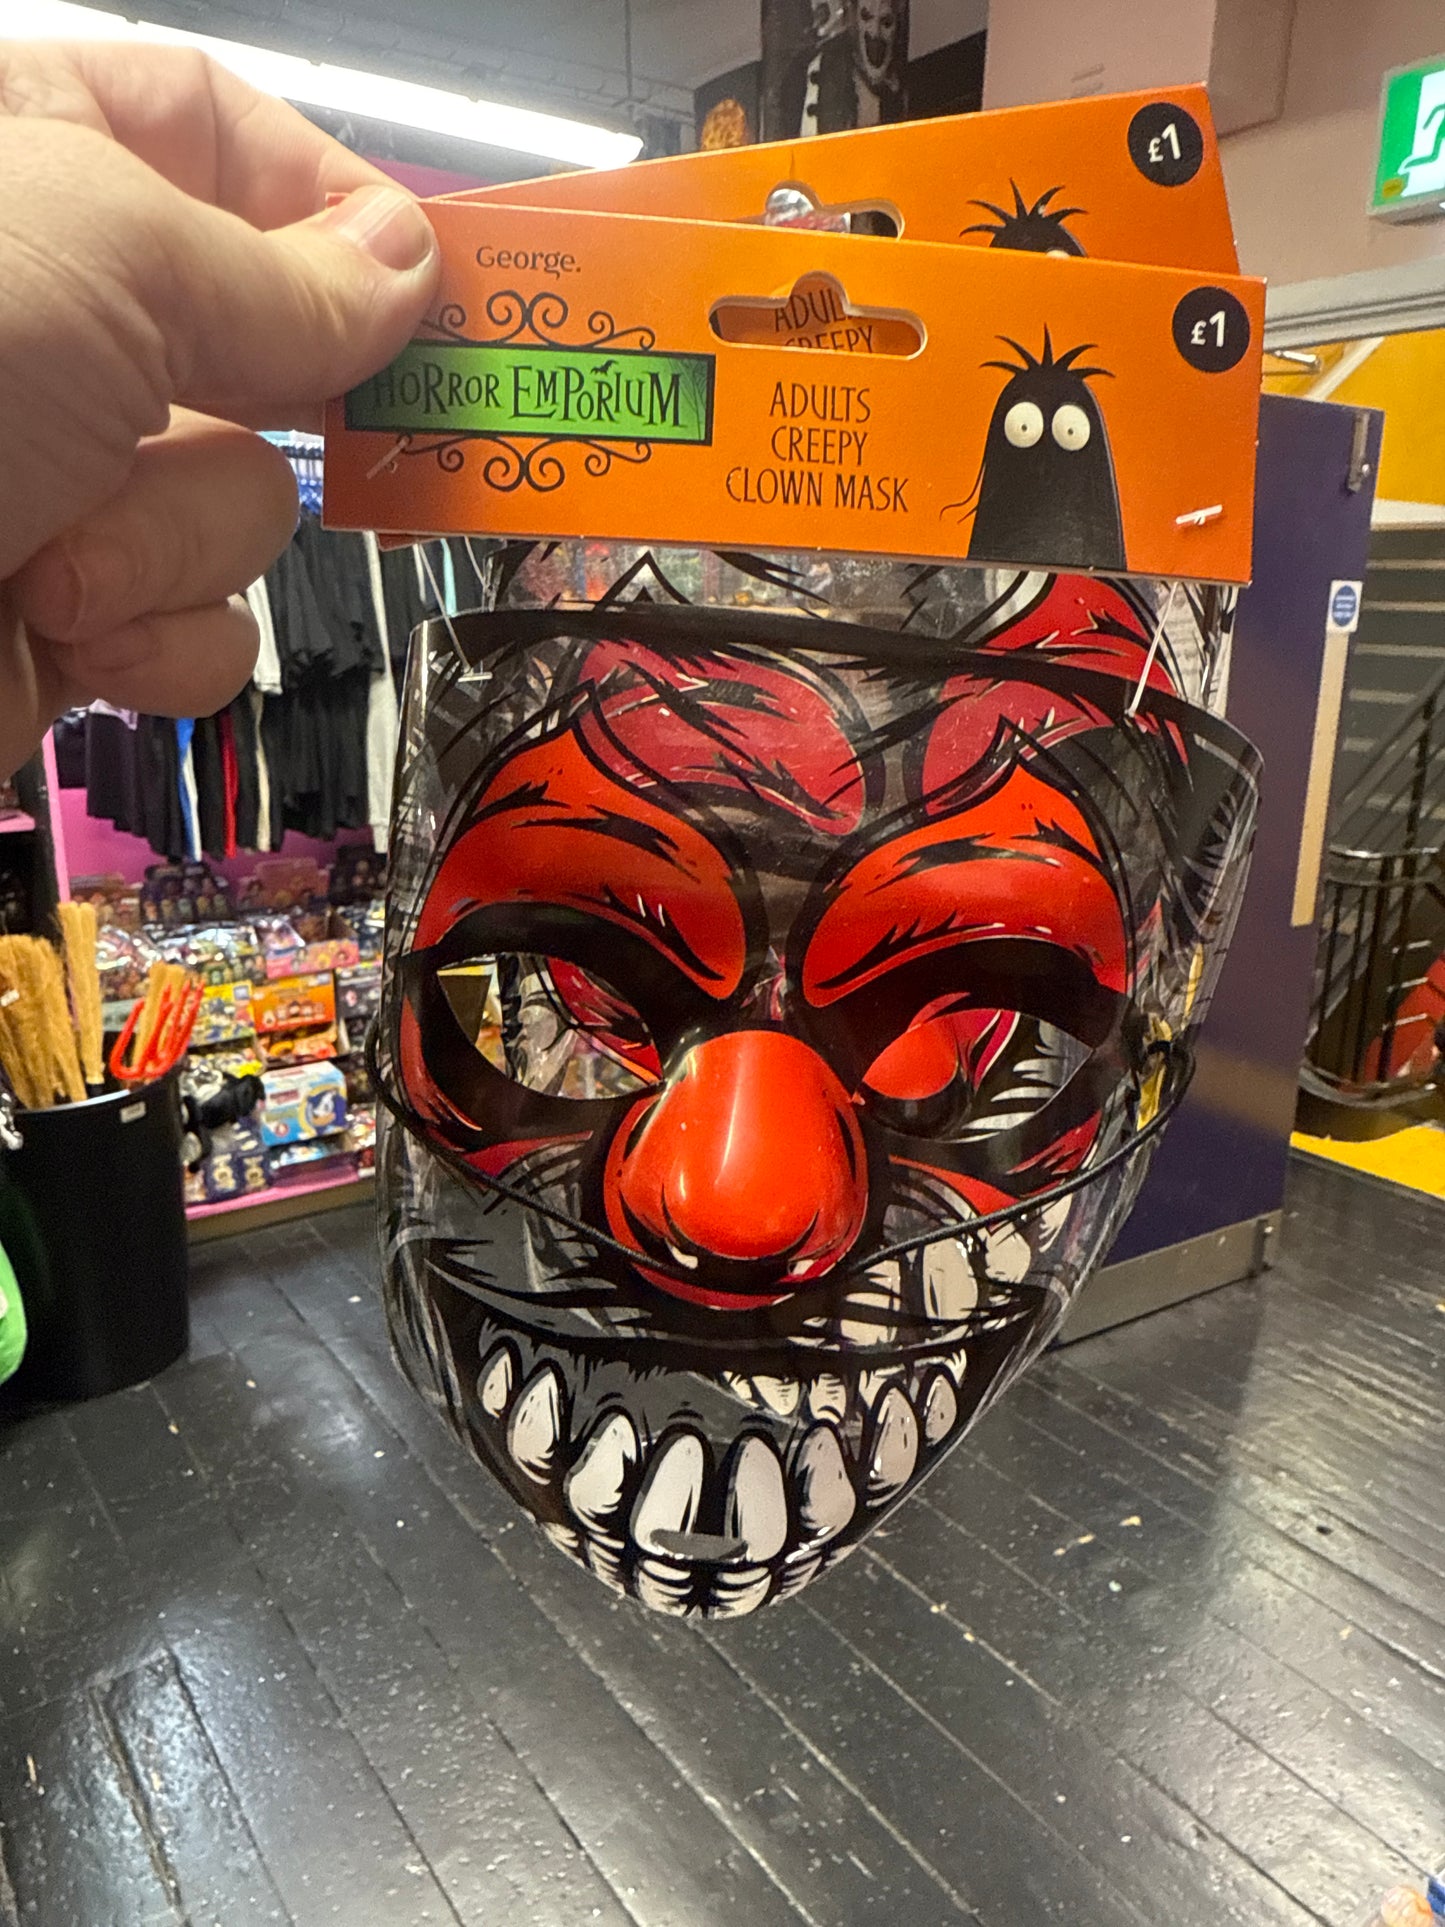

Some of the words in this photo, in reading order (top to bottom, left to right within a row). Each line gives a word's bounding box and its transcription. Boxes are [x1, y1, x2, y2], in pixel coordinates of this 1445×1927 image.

[1148, 123, 1182, 162] £1
[1190, 310, 1227, 348] £1
[508, 364, 685, 428] EMPORIUM
[769, 381, 871, 423] ADULTS
[771, 425, 868, 466] CREEPY
[726, 466, 823, 507] CLOWN
[834, 473, 909, 513] MASK
